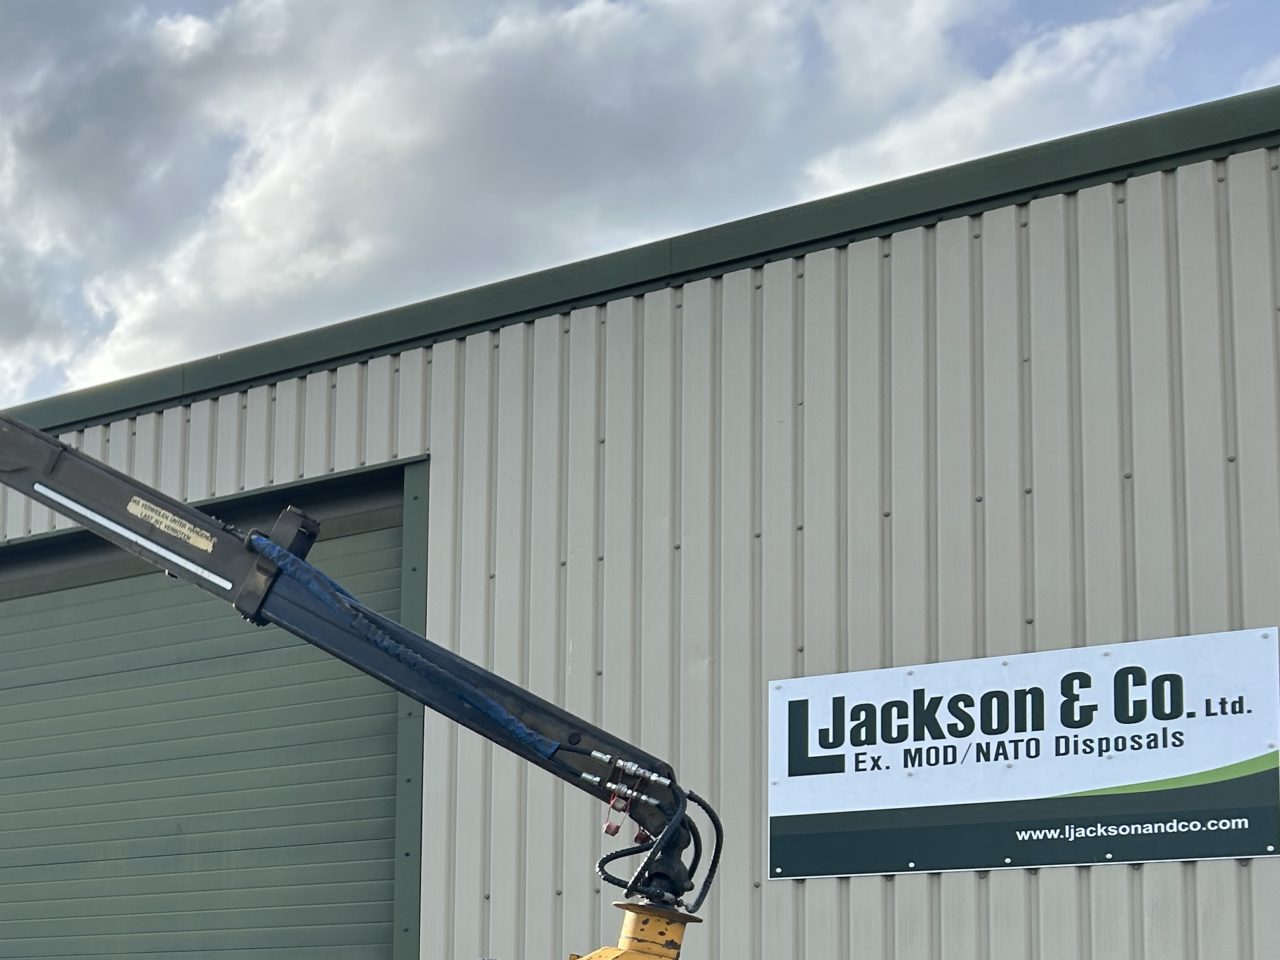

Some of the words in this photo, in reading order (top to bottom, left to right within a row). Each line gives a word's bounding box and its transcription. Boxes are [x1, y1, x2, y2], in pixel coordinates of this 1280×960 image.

[1060, 671, 1098, 729] &
[1113, 665, 1196, 725] Co.
[1205, 696, 1253, 717] Ltd.
[854, 752, 891, 773] Ex.
[903, 737, 1041, 769] MOD/NATO
[1055, 727, 1185, 758] Disposals
[1016, 817, 1249, 842] www.ljacksonandco.com
